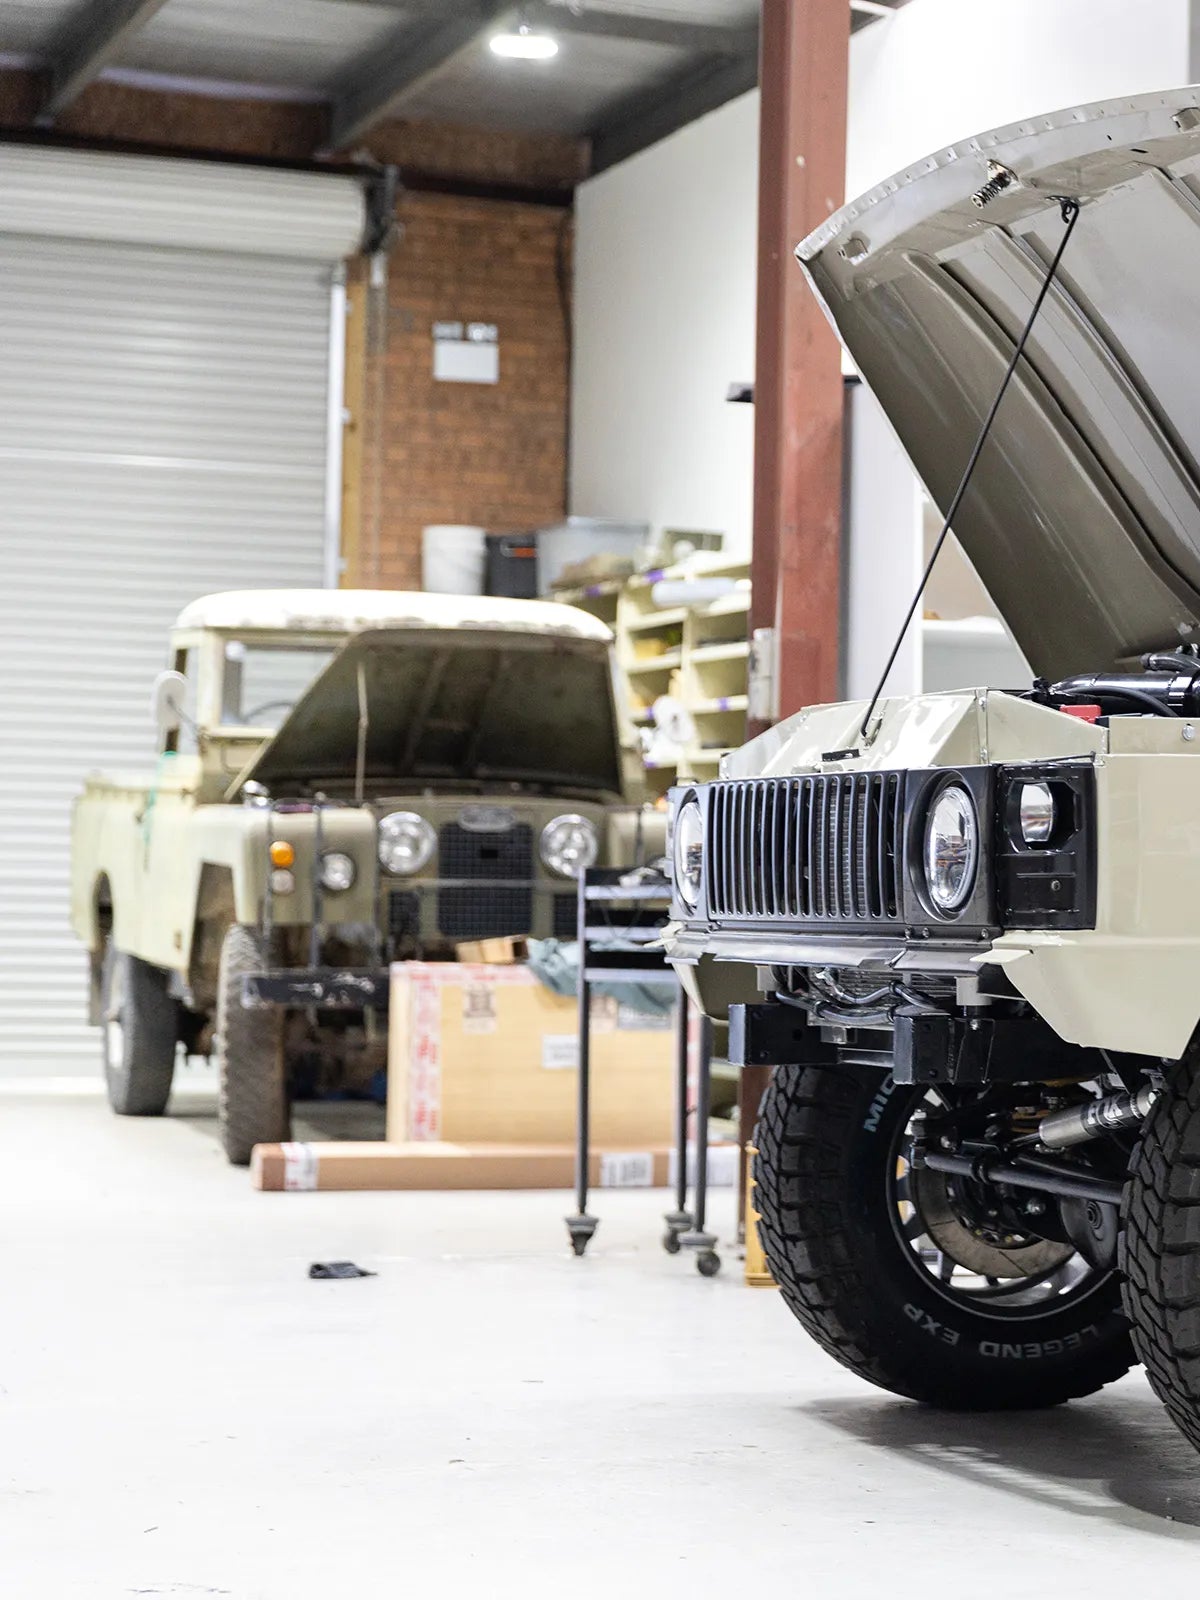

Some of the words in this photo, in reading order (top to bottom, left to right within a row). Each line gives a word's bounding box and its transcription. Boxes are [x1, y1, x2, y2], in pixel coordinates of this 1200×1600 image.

[864, 1072, 895, 1132] MIC
[904, 1303, 959, 1347] EXP
[979, 1323, 1098, 1359] LEGEND
